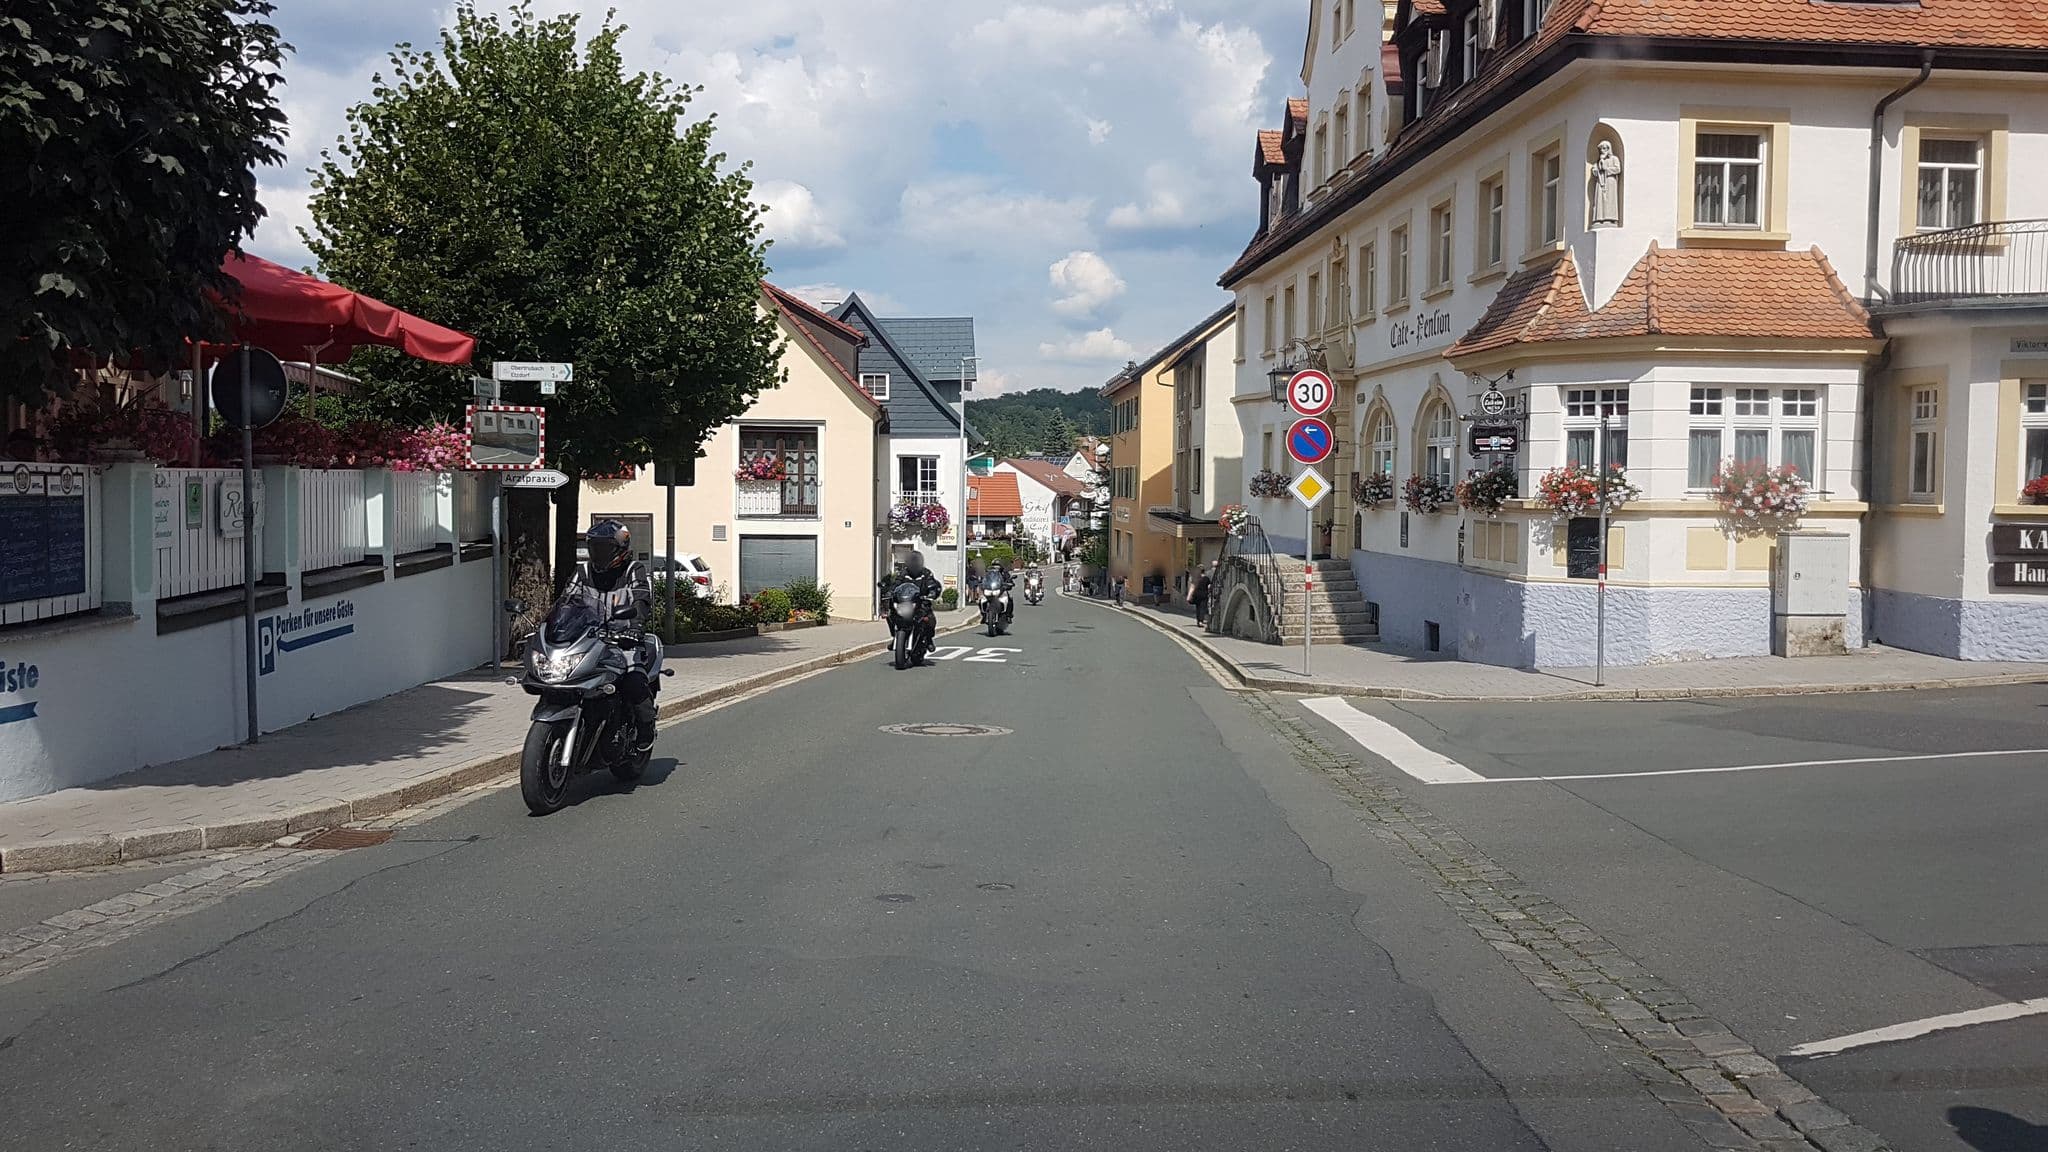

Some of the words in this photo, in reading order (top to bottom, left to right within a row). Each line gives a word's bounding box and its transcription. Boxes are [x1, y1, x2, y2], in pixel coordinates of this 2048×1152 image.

[1298, 383, 1323, 403] 30
[506, 474, 556, 483] Arztpraxis
[2015, 562, 2048, 582] Hau
[276, 612, 302, 635] Parken
[304, 607, 313, 628] für
[315, 606, 336, 625] unsere
[337, 600, 354, 619] Gäste
[261, 626, 272, 669] P
